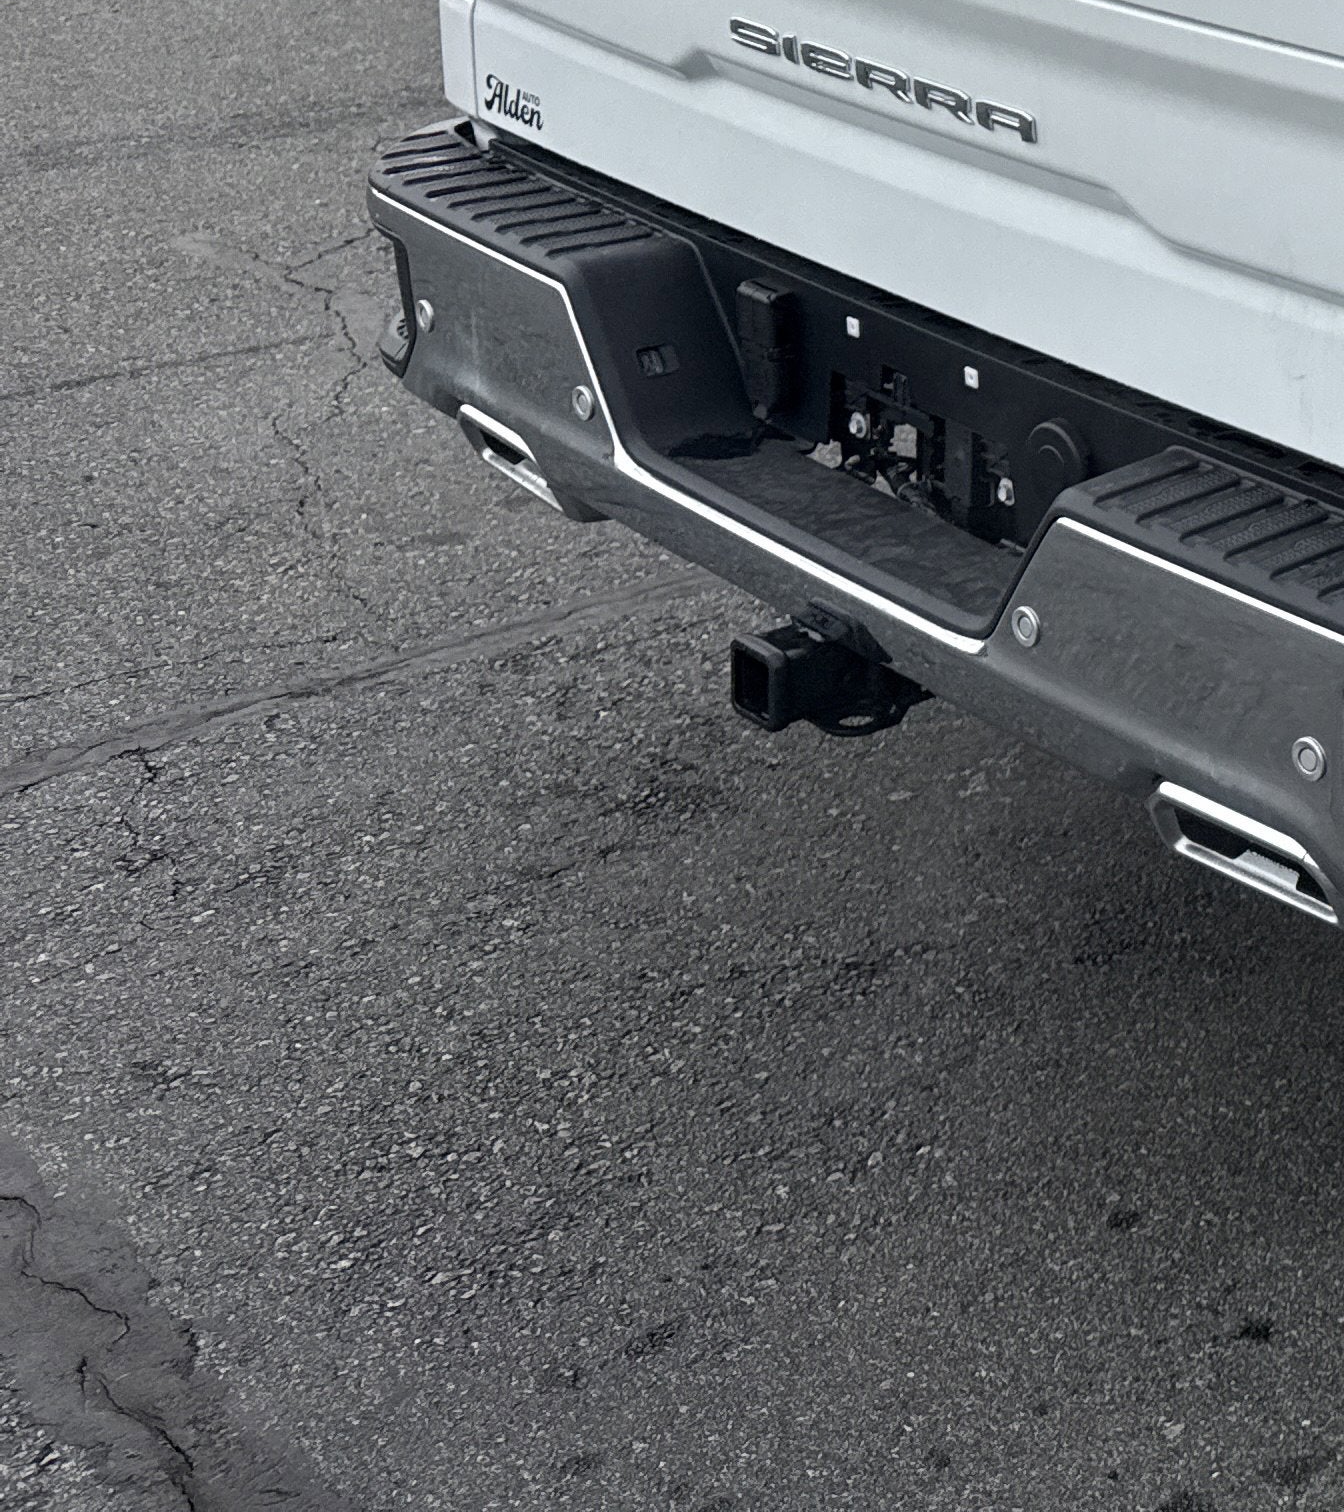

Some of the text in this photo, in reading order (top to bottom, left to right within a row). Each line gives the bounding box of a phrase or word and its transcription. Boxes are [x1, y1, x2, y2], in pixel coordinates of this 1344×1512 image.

[484, 73, 544, 131] Alden
[522, 91, 541, 107] AUTO
[729, 16, 1039, 144] SIERRA
